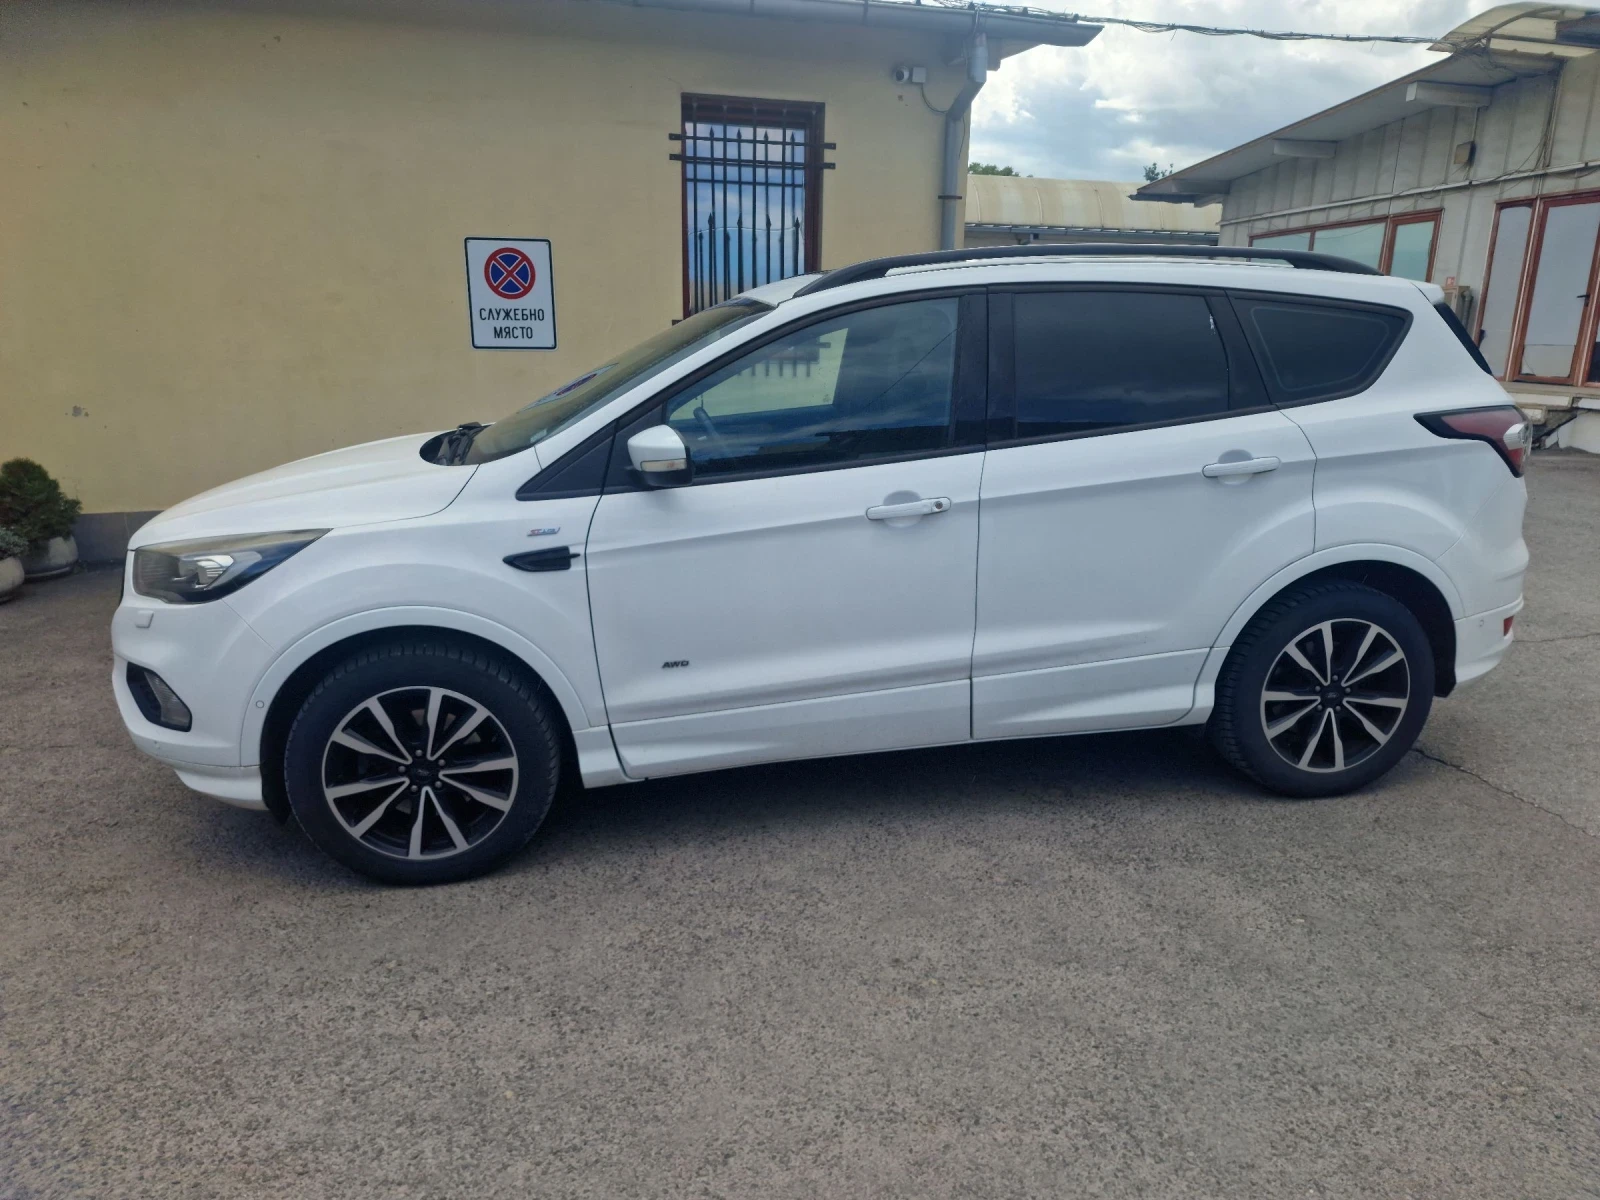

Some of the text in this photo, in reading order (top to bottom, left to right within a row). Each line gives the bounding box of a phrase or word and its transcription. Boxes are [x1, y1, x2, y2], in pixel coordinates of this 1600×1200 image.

[479, 307, 545, 321] СЛУЖЕБНО
[493, 326, 534, 339] МЯСТО
[661, 660, 690, 669] AWD
